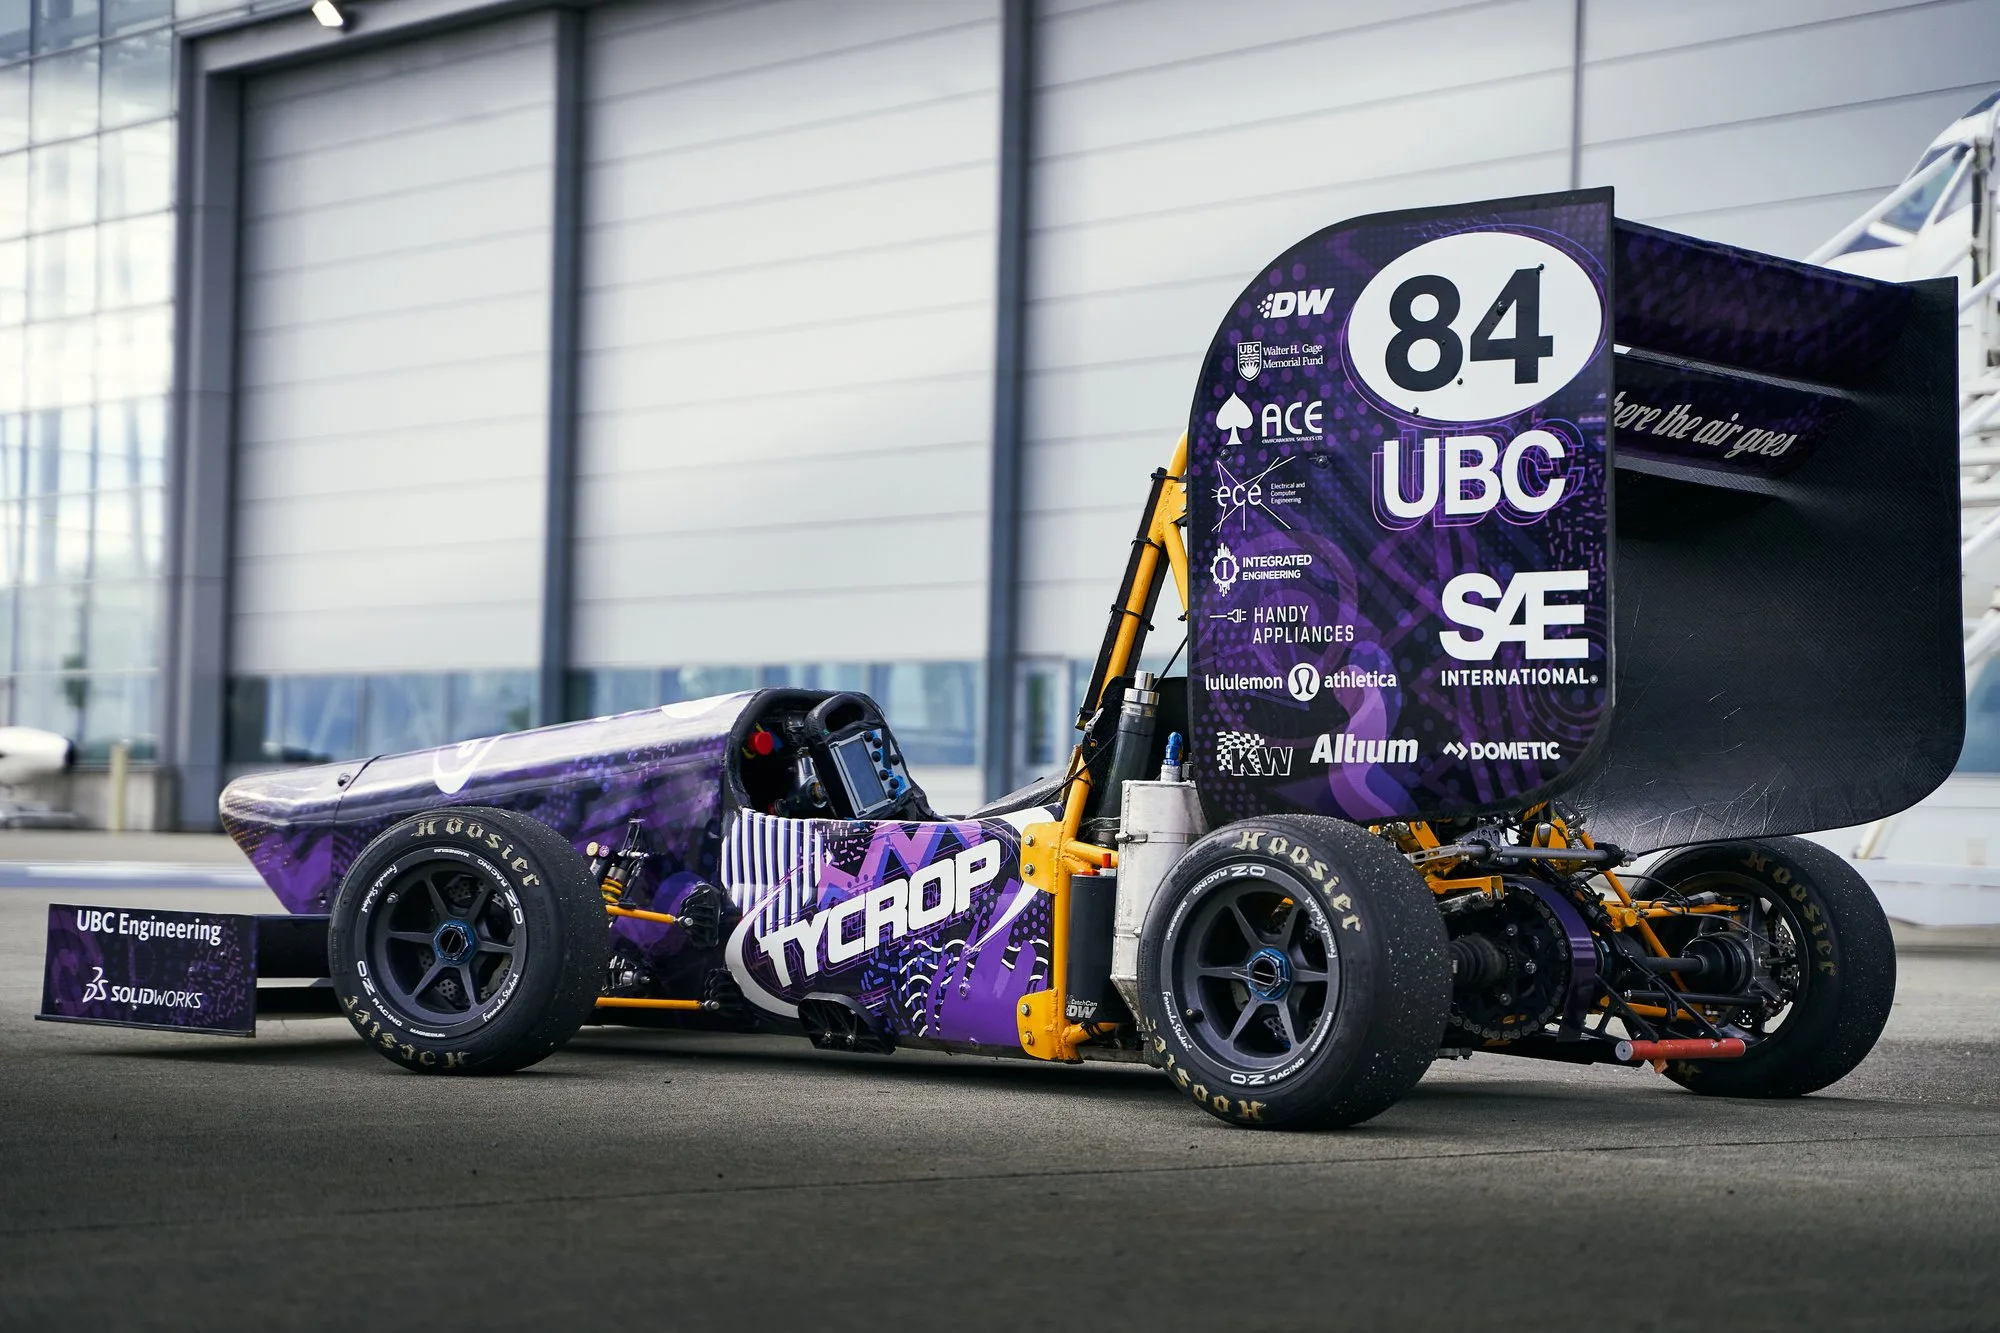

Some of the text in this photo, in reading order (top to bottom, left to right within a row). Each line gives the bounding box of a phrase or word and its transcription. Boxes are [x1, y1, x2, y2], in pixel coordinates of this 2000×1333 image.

[1270, 288, 1335, 318] DW
[1385, 266, 1553, 392] 84
[1240, 344, 1260, 354] UBC
[1263, 346, 1289, 356] Walter
[1302, 344, 1322, 354] Gage
[1263, 355, 1324, 369] Memorial Fund
[1262, 401, 1322, 437] ACE
[1652, 404, 1702, 439] the
[1693, 412, 1743, 446] air
[1724, 428, 1798, 459] goes
[1271, 482, 1295, 490] Electrical
[1383, 430, 1566, 518] UBC
[1271, 490, 1297, 498] Computer
[1271, 497, 1302, 505] Engineering
[1243, 554, 1313, 568] INTEGRATED
[1243, 570, 1301, 581] ENGINEERING
[1254, 605, 1309, 624] HANDY
[1439, 570, 1589, 661] SAE
[1253, 625, 1355, 645] APPLIANCES
[1205, 671, 1397, 691] lululemon athletica
[1231, 746, 1294, 776] KW
[1310, 733, 1419, 764] Altium
[1470, 741, 1561, 761] DOMETIC
[411, 818, 540, 887] Hoosier
[477, 858, 508, 888] RACING
[1192, 869, 1228, 896] RACING
[1232, 831, 1362, 932] Hoosier
[760, 838, 1001, 988] TYCROP
[76, 909, 222, 946] UBC Engineering
[110, 986, 203, 1009] SOLIDWORKS
[371, 997, 403, 1027] RACING
[1068, 1005, 1096, 1018] DW
[1269, 1057, 1305, 1082] RACING
